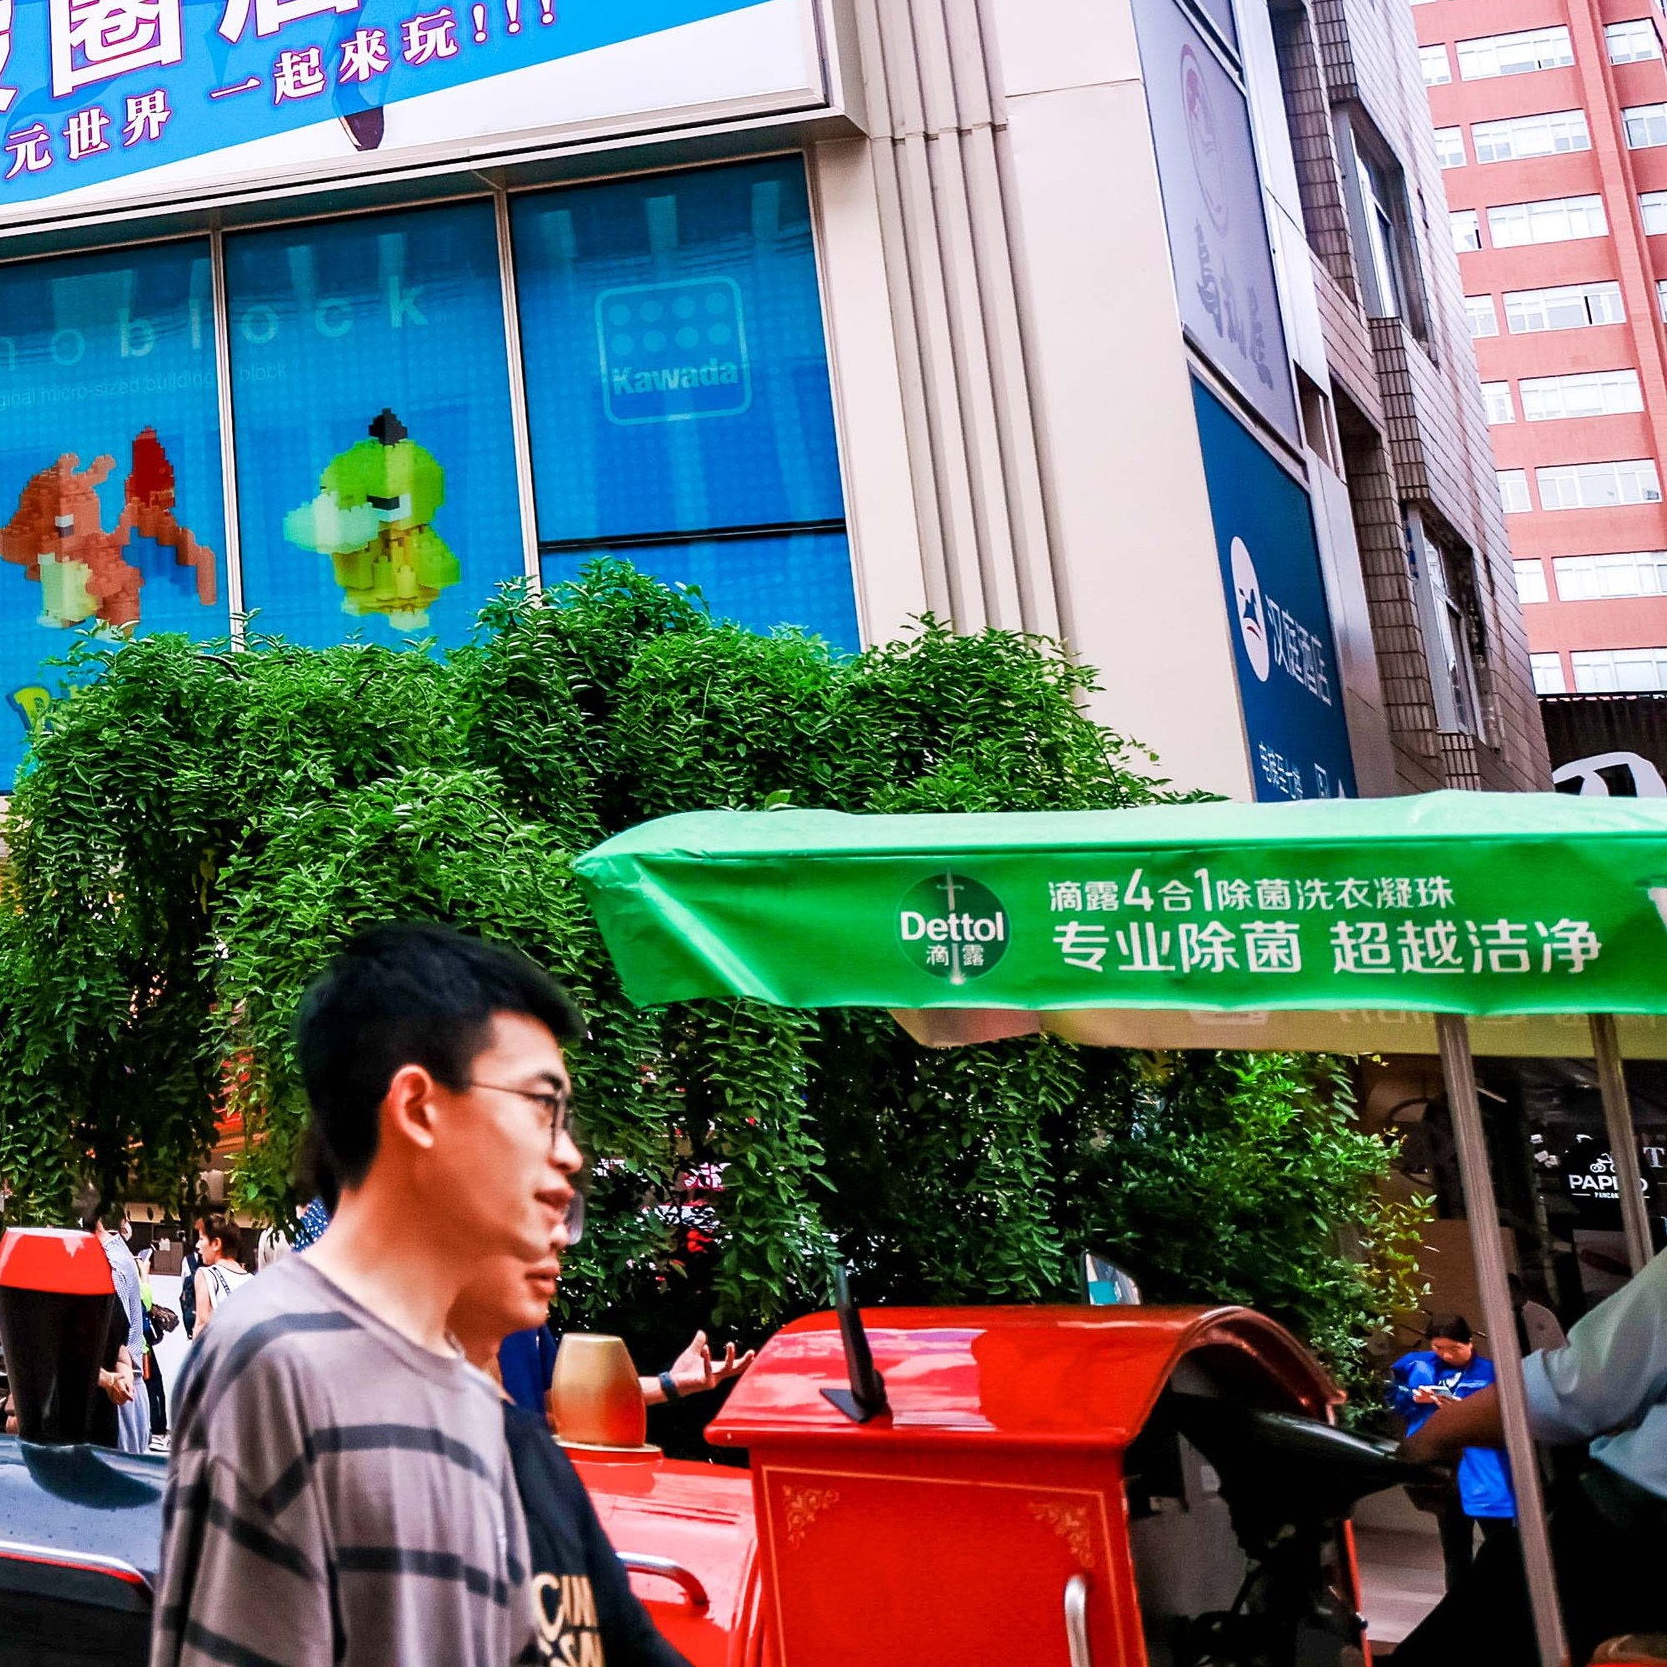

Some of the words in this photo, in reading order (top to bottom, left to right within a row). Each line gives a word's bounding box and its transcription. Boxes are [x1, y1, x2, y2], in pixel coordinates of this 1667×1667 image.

[610, 355, 740, 396] Kawada
[1265, 594, 1332, 707] 汉庭酒店
[1048, 868, 1455, 914] 滴露4合1除菌洗衣凝珠
[901, 911, 1004, 942] Dettol
[1053, 919, 1302, 975] 专业除菌
[1332, 917, 1604, 976] 超越洁净
[925, 943, 986, 967] 滴露
